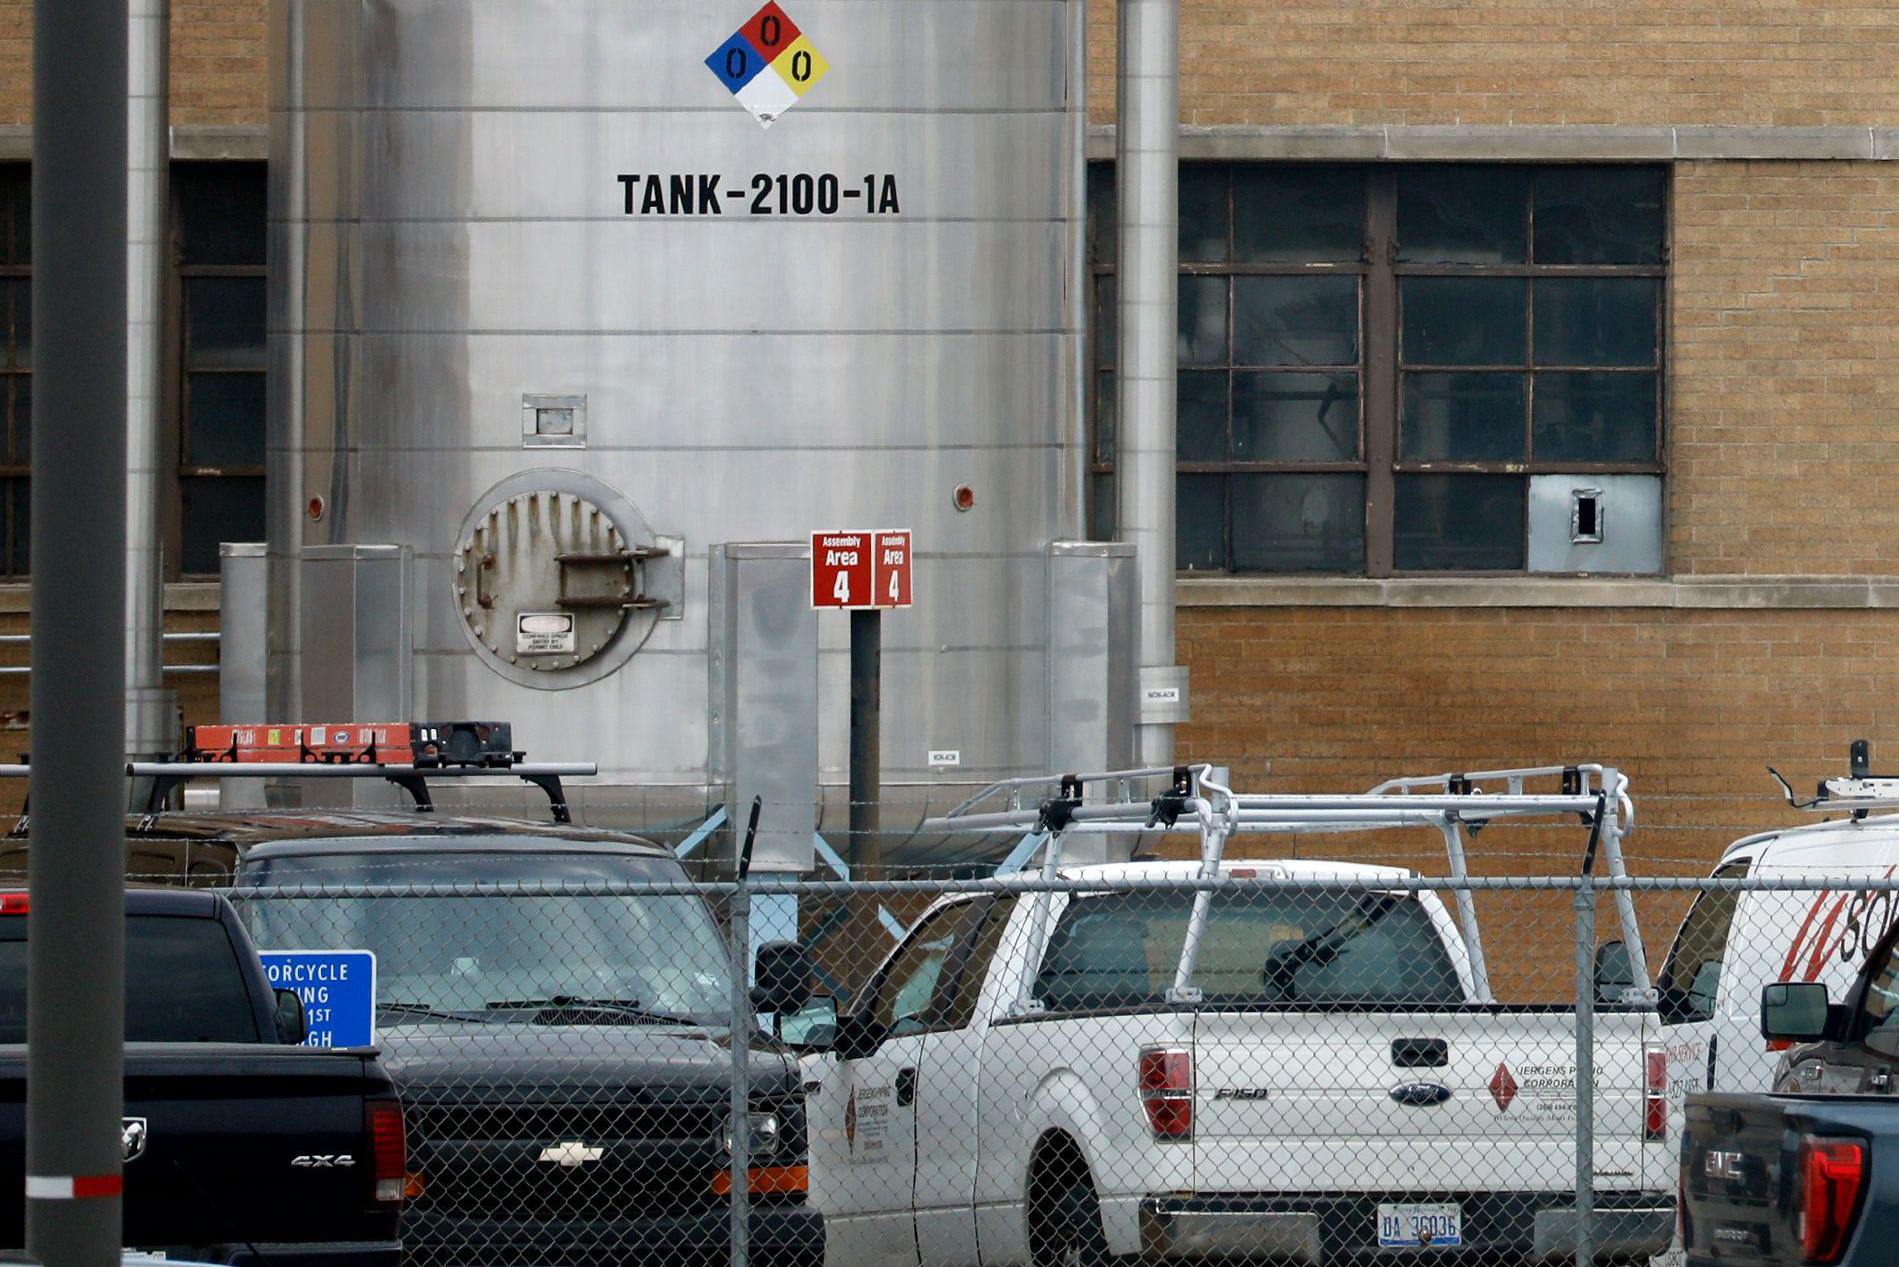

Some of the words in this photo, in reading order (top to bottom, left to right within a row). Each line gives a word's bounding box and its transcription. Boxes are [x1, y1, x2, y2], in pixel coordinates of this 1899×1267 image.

[761, 15, 781, 46] 0
[726, 47, 746, 79] 0
[791, 50, 811, 82] 0
[617, 173, 900, 215] TANK-2100-1A
[823, 537, 861, 548] Assembly
[881, 536, 905, 546] Assembly
[825, 549, 858, 566] Area
[883, 549, 904, 565] Area
[833, 570, 850, 603] 4
[888, 570, 899, 602] 4
[263, 964, 348, 982] ORCYCLE
